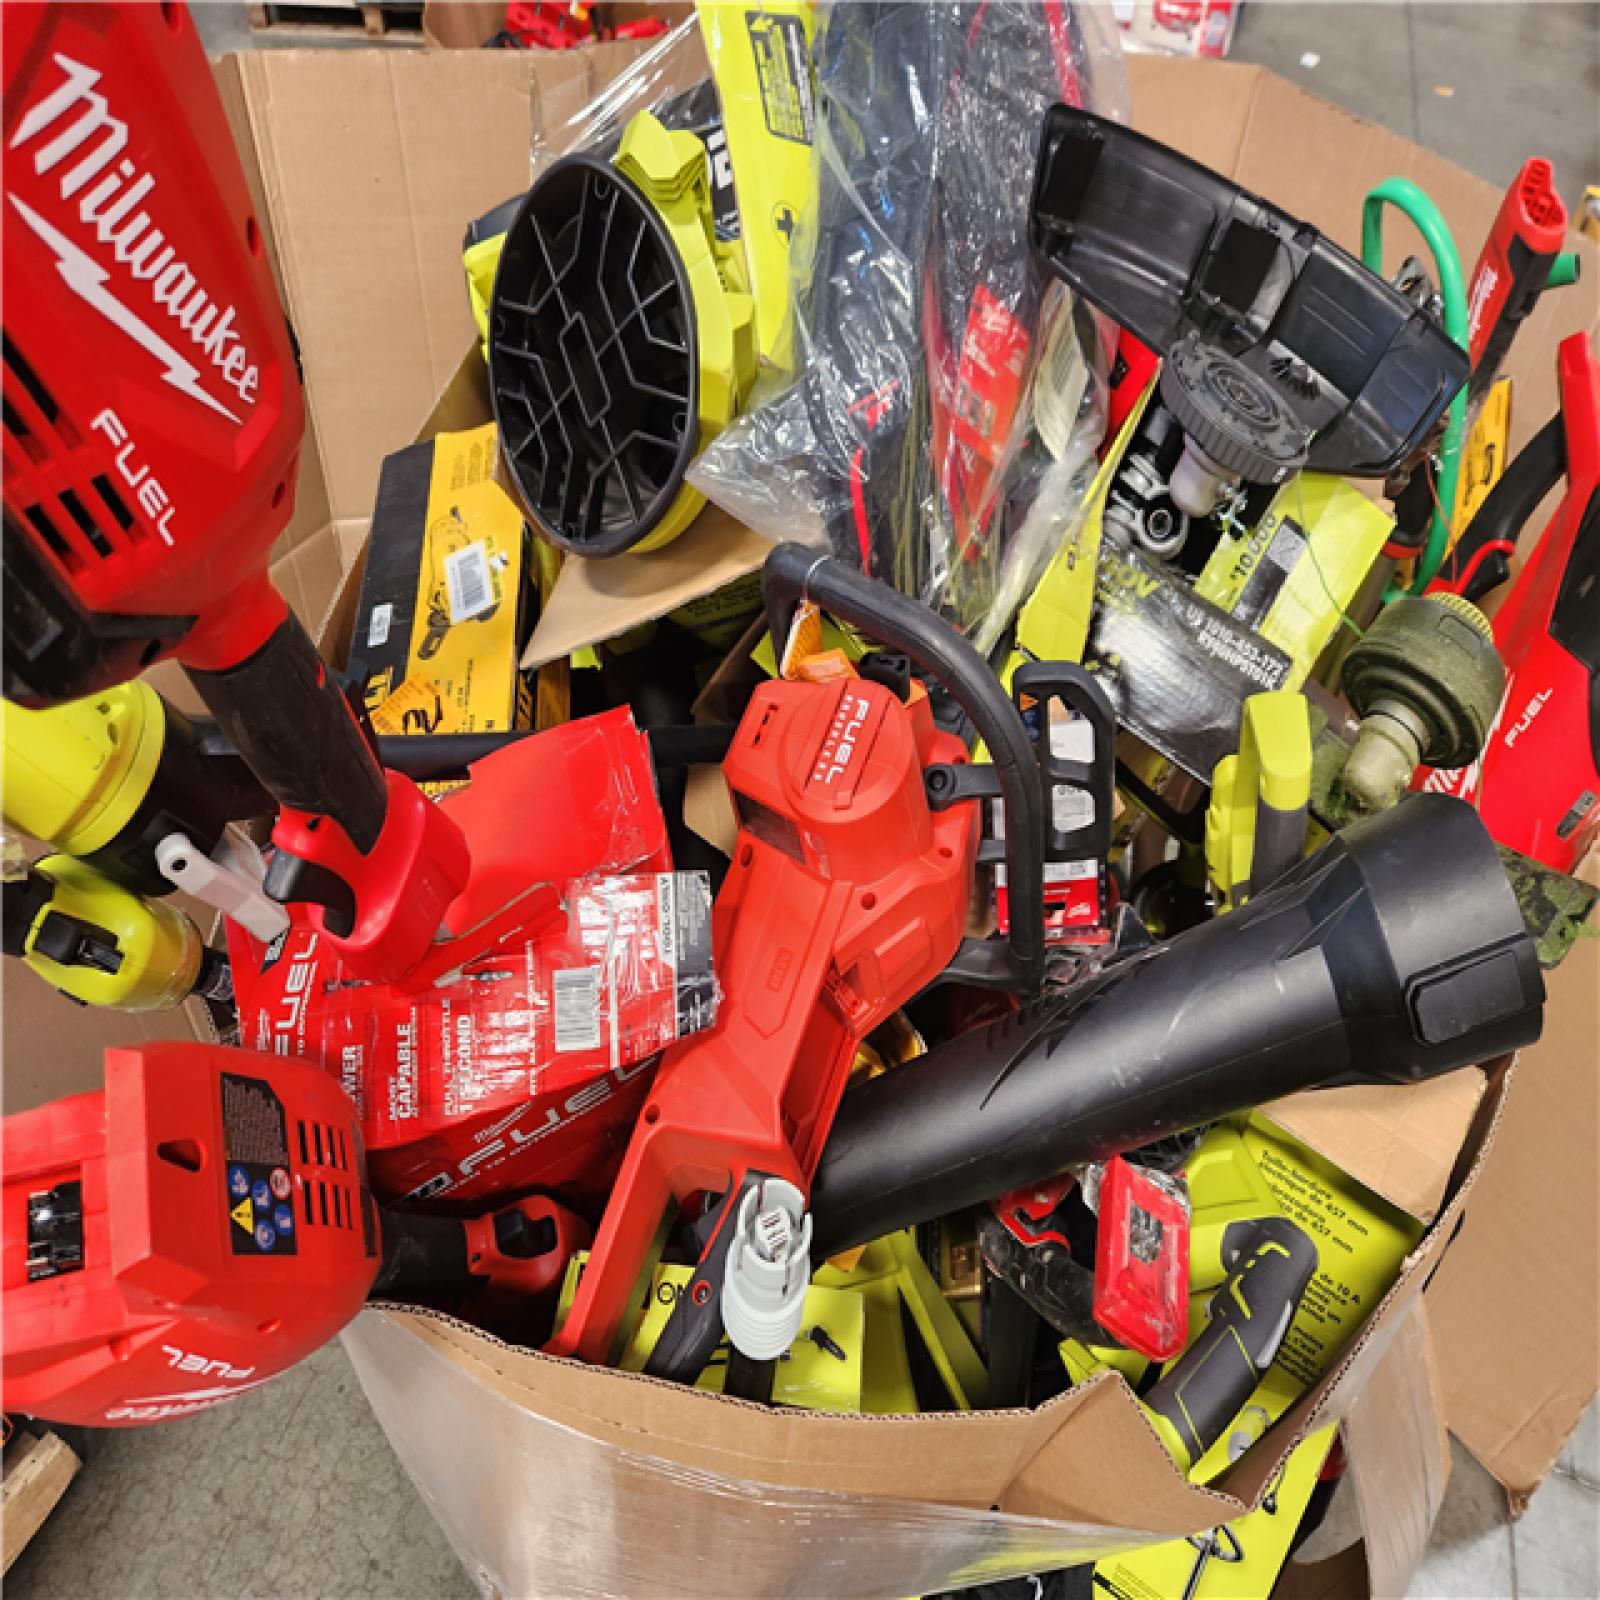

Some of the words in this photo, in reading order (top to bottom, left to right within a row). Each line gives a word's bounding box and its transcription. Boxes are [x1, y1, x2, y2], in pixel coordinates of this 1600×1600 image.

[9, 52, 259, 403] Milwaukee
[90, 407, 176, 546] FUEL
[826, 699, 869, 784] FUEL
[1504, 687, 1553, 748] FUEL
[397, 1024, 411, 1118] CAPABLE
[161, 1344, 256, 1379] FUEL
